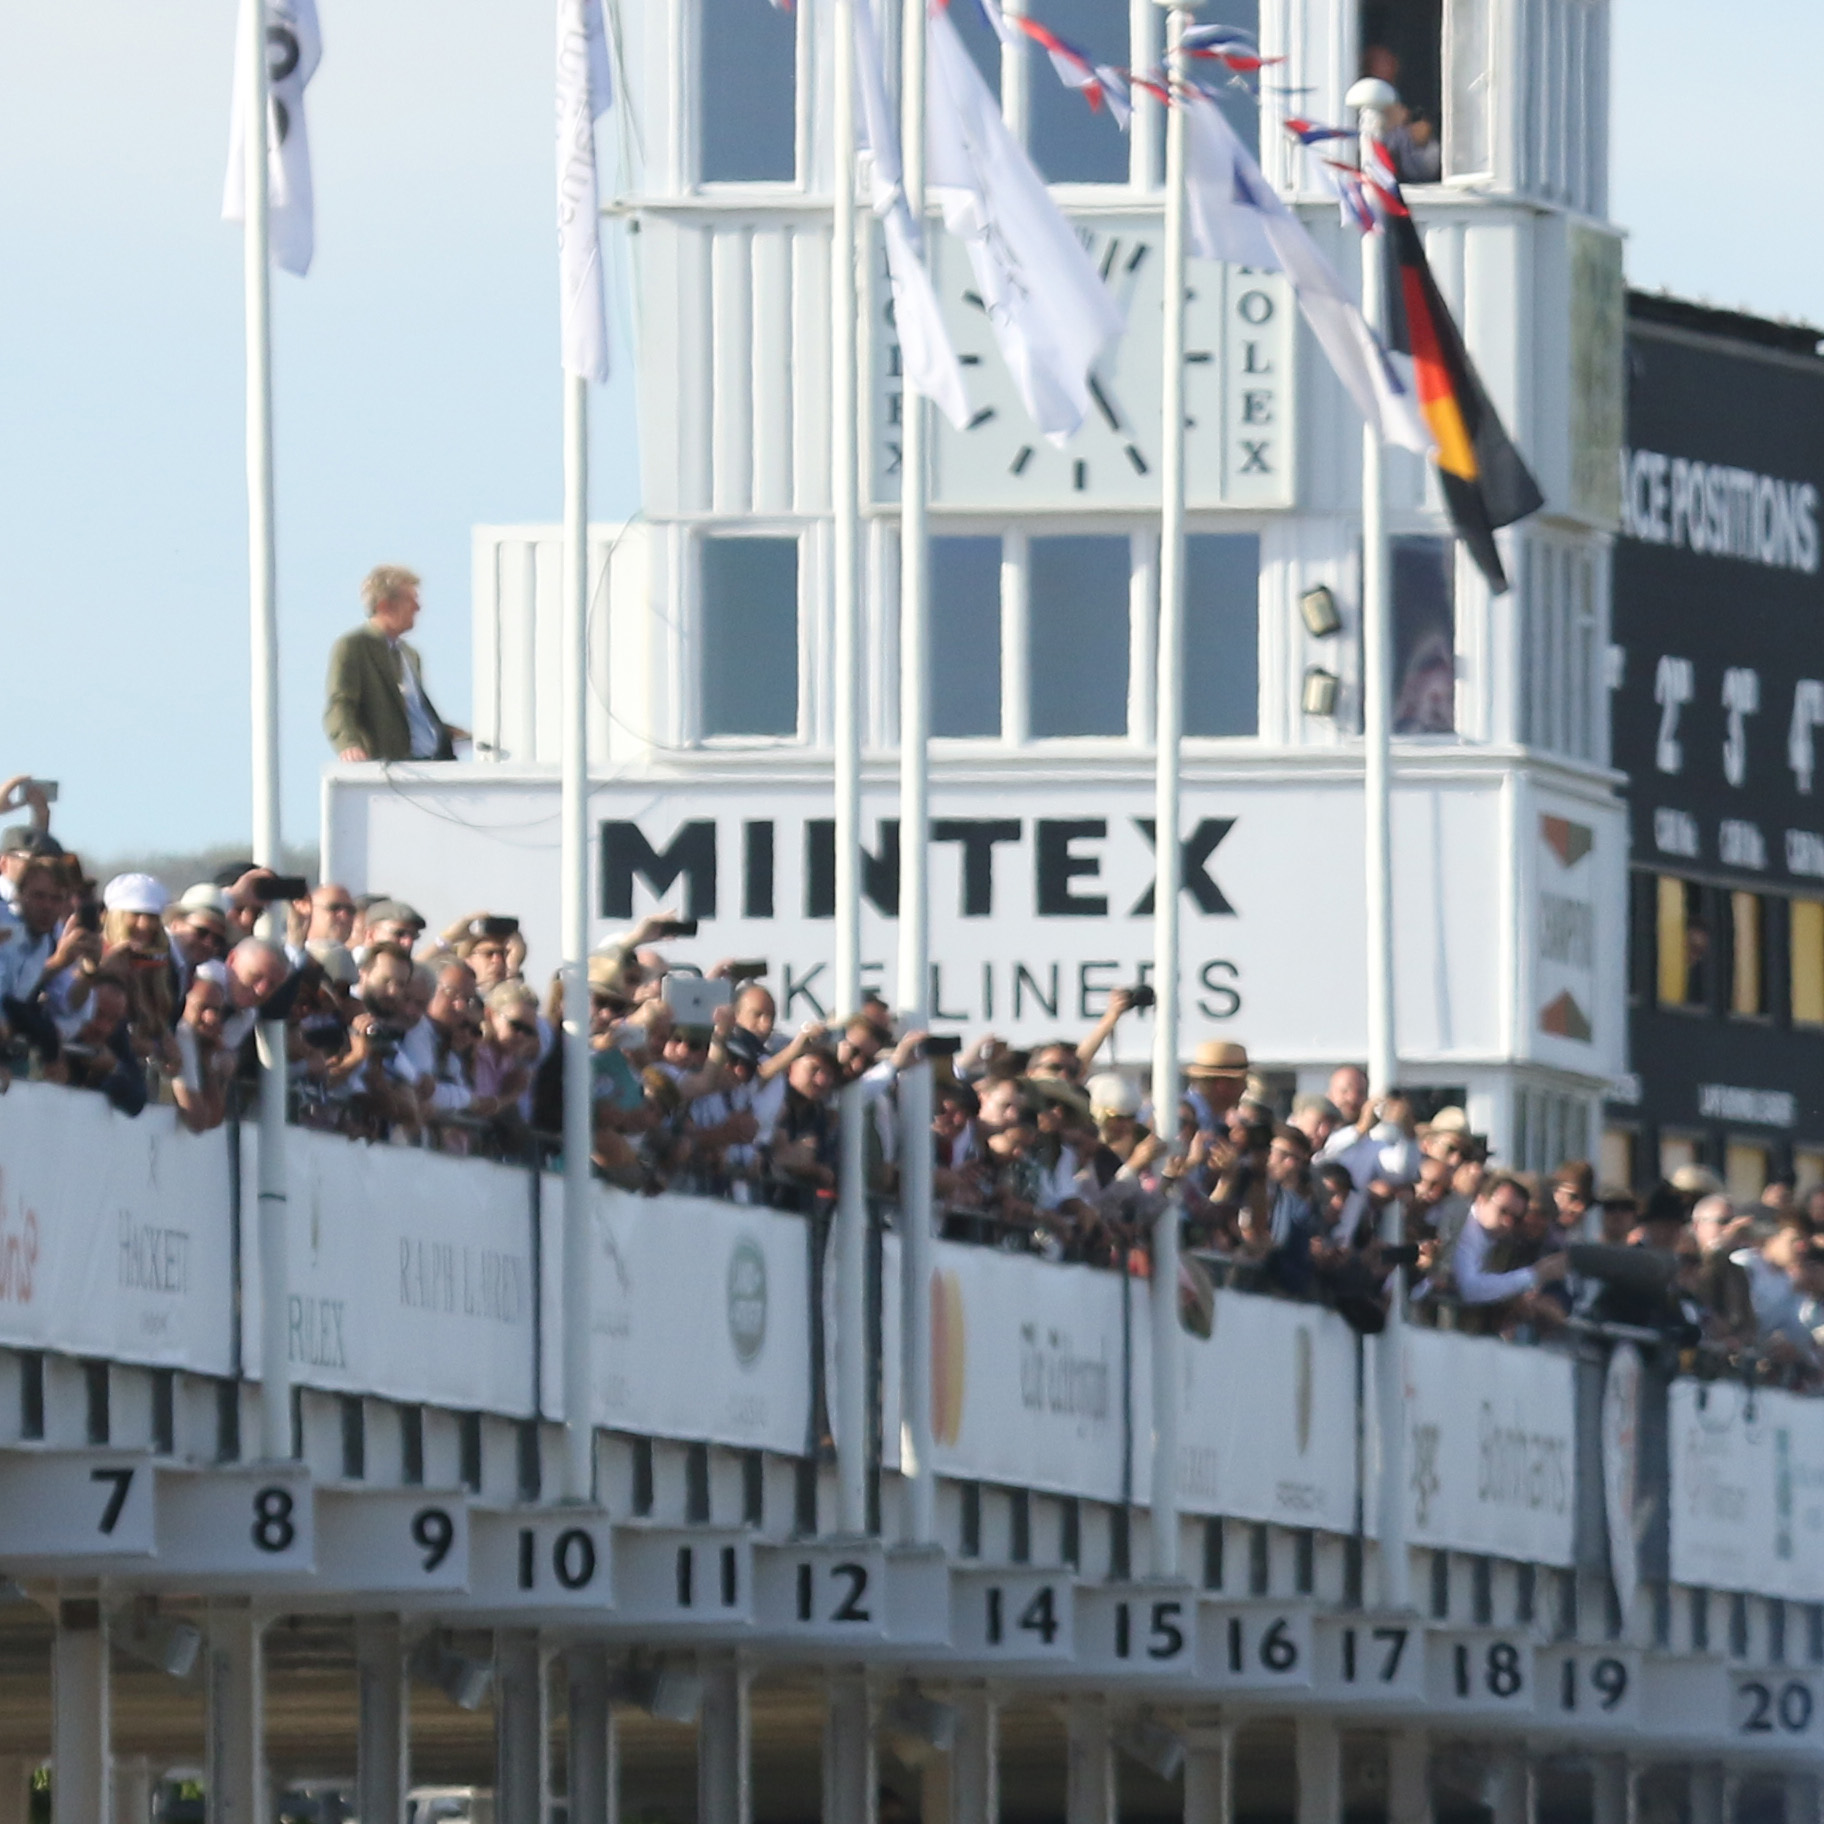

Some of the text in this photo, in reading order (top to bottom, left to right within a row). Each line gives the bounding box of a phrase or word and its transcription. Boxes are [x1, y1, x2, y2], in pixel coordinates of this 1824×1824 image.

[1236, 264, 1275, 474] OLEX
[1671, 457, 1821, 575] POSITIONS
[597, 817, 1240, 919] MINTEX
[89, 1468, 135, 1535] 7
[252, 1487, 294, 1553] 8
[411, 1508, 454, 1573] 9
[518, 1529, 595, 1590] 10
[677, 1547, 736, 1607] 11
[797, 1563, 870, 1622] 12
[986, 1588, 1058, 1645] 14
[1115, 1603, 1183, 1660] 15
[1227, 1619, 1299, 1674] 16
[1342, 1628, 1409, 1683] 17
[1454, 1641, 1523, 1698] 18
[1561, 1656, 1629, 1711] 19
[1739, 1682, 1814, 1733] 20
